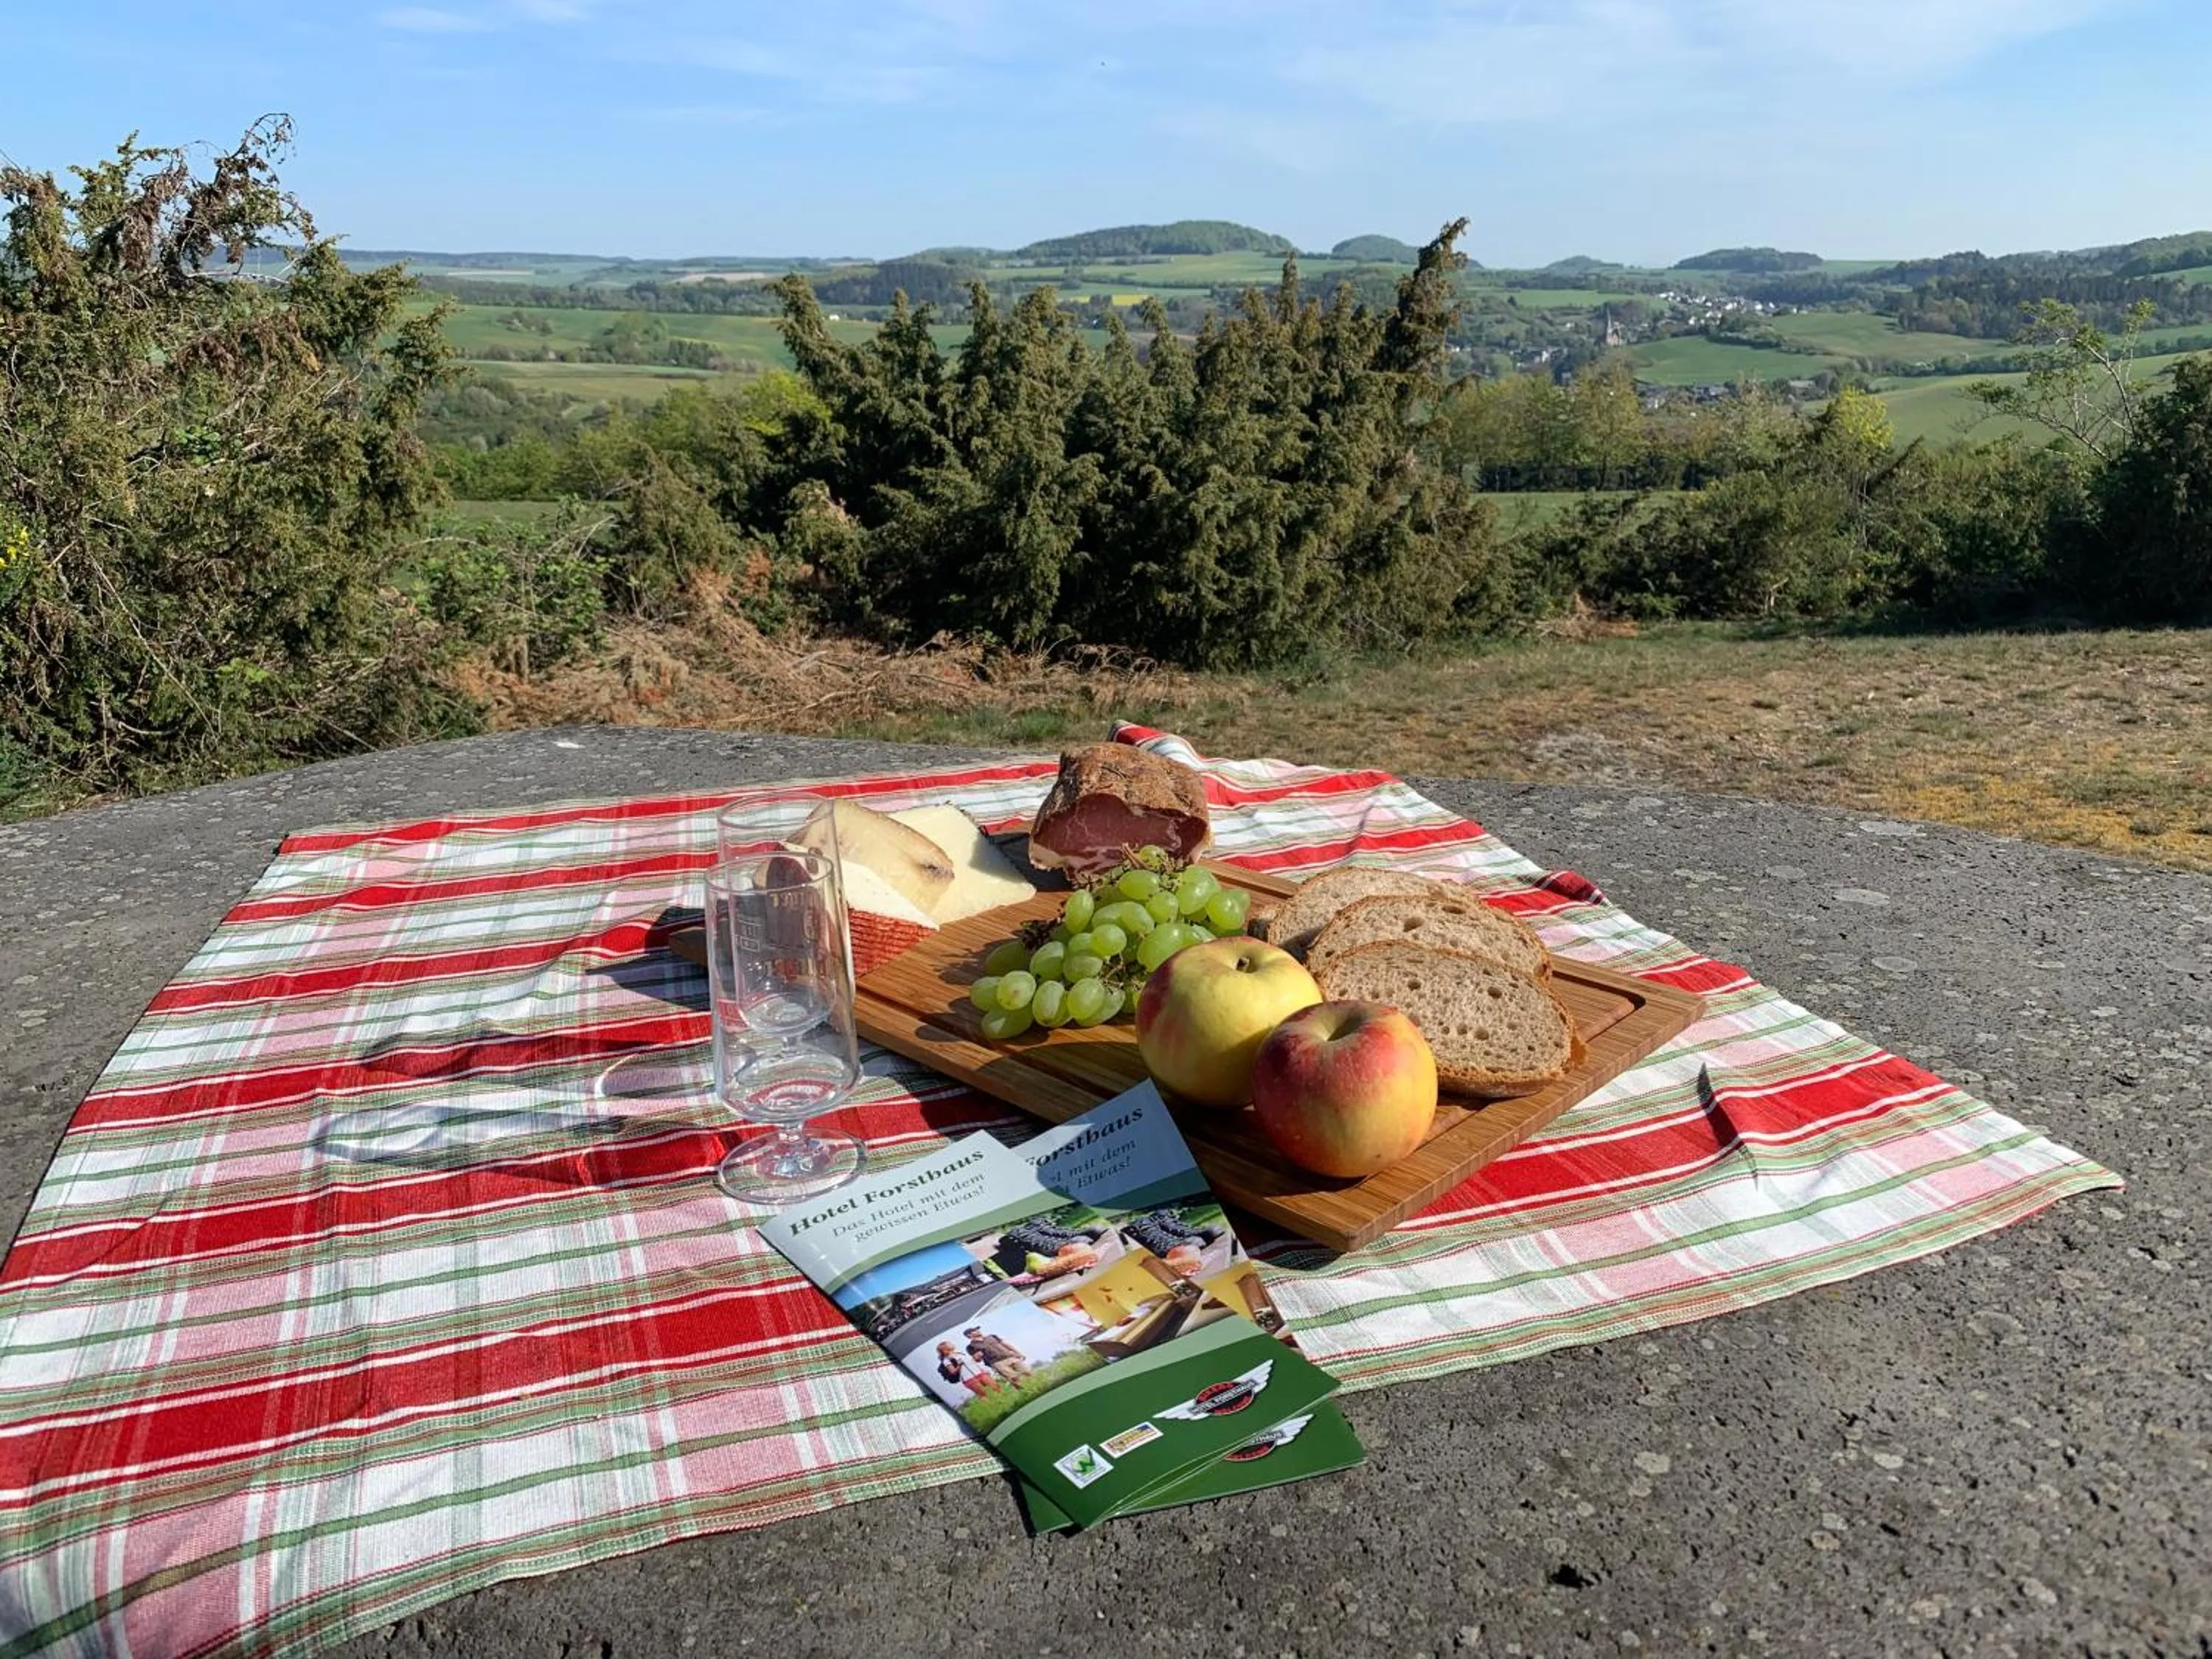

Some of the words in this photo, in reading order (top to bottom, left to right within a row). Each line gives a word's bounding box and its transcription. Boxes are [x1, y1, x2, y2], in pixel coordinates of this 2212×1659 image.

[1069, 1158, 1096, 1178] mit
[1101, 1139, 1136, 1164] dem
[1077, 1155, 1131, 1189] Etwas!
[789, 1197, 859, 1237] Hotel
[863, 1150, 984, 1204] Forsthaus
[832, 1220, 866, 1237] Das
[869, 1200, 914, 1222] Hotel
[919, 1189, 946, 1205] mit
[951, 1173, 985, 1193] dem
[855, 1209, 928, 1242] gewissen
